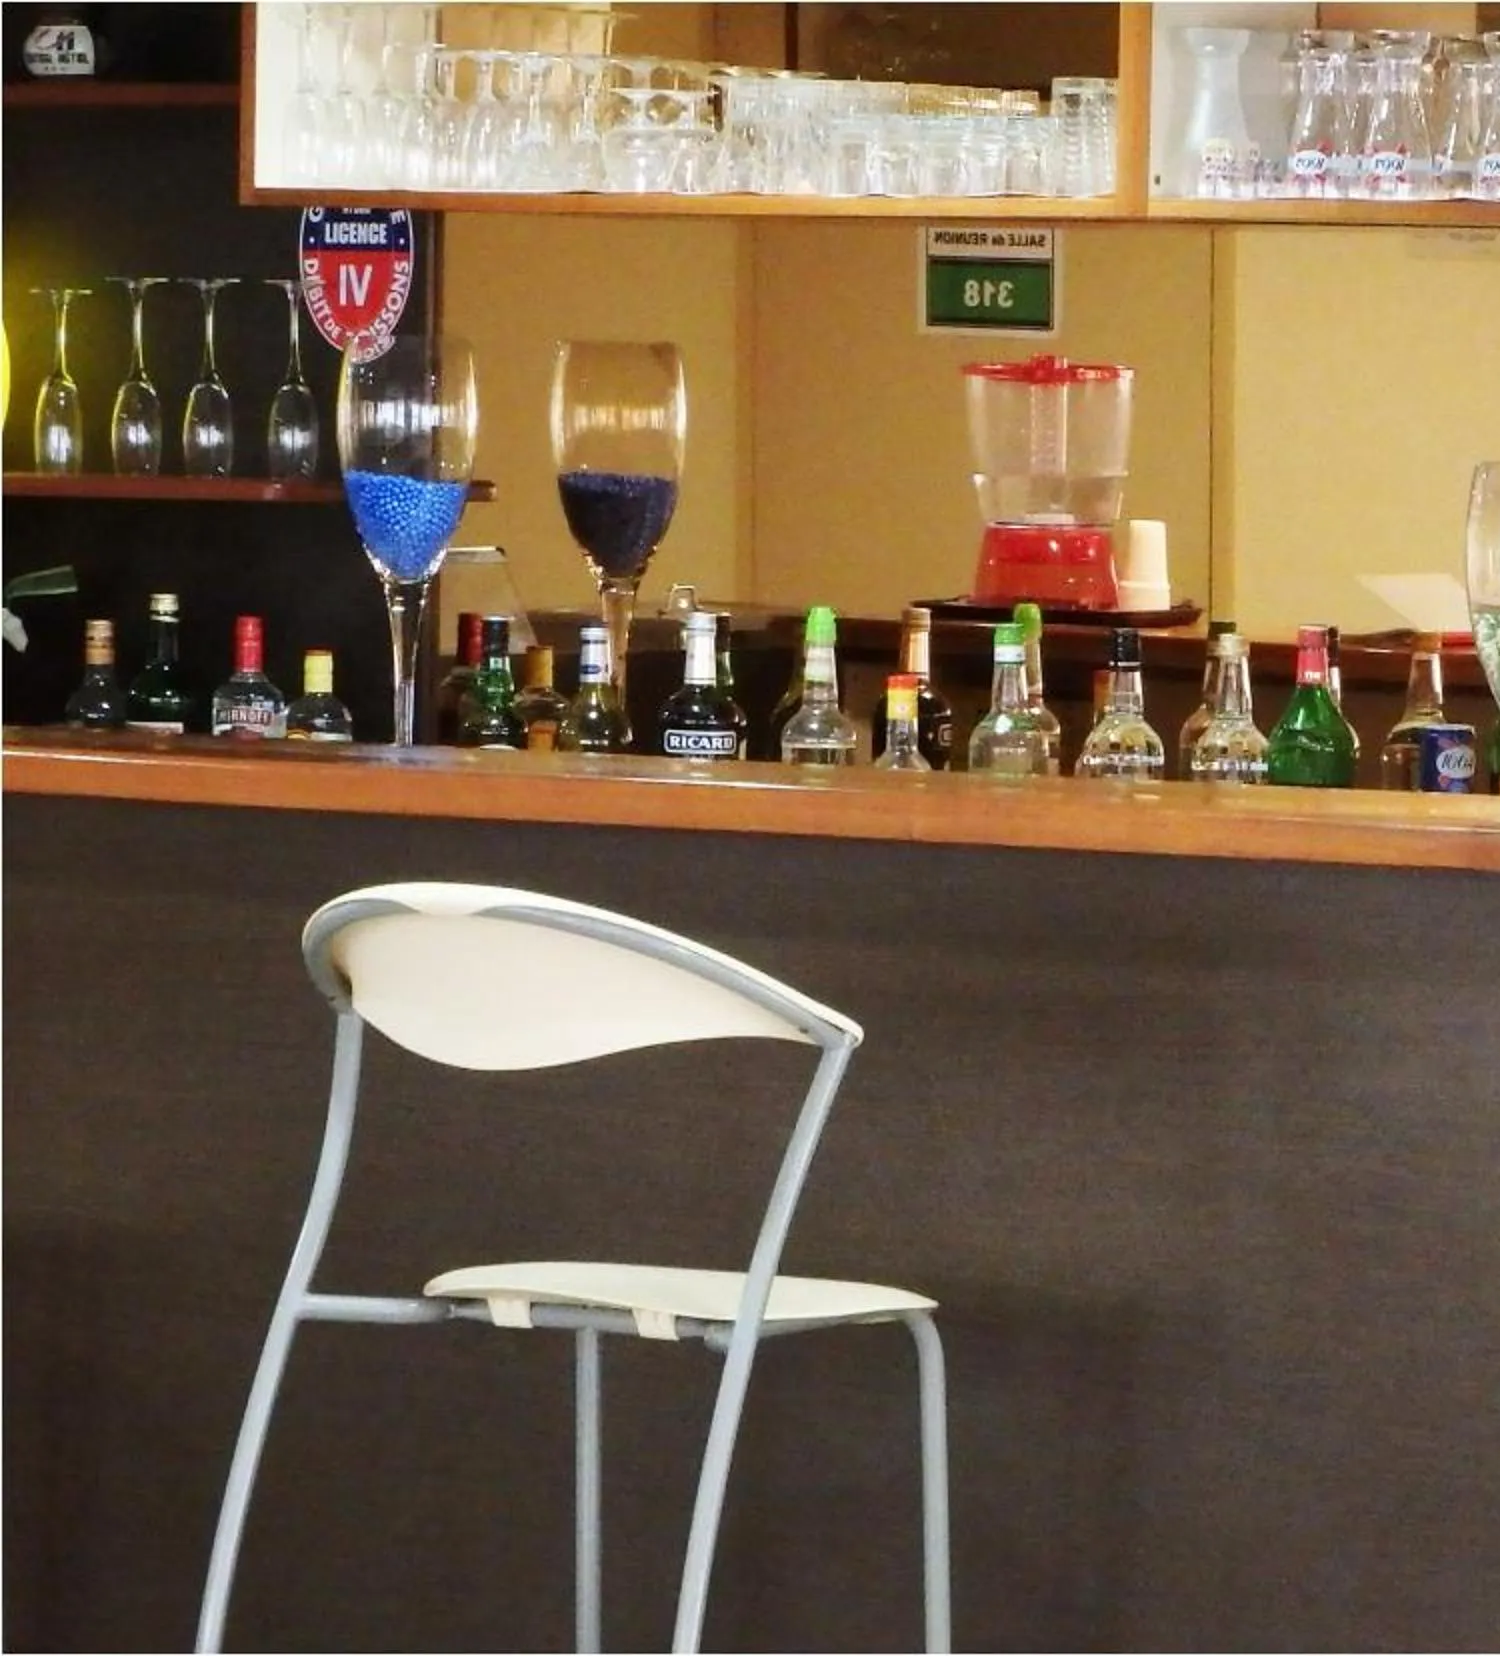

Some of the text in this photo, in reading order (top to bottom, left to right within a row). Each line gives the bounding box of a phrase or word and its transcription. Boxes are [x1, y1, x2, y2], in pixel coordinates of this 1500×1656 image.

[324, 222, 388, 245] LICENCE
[339, 263, 374, 307] IV
[323, 318, 343, 341] DE
[669, 735, 733, 749] RICARD
